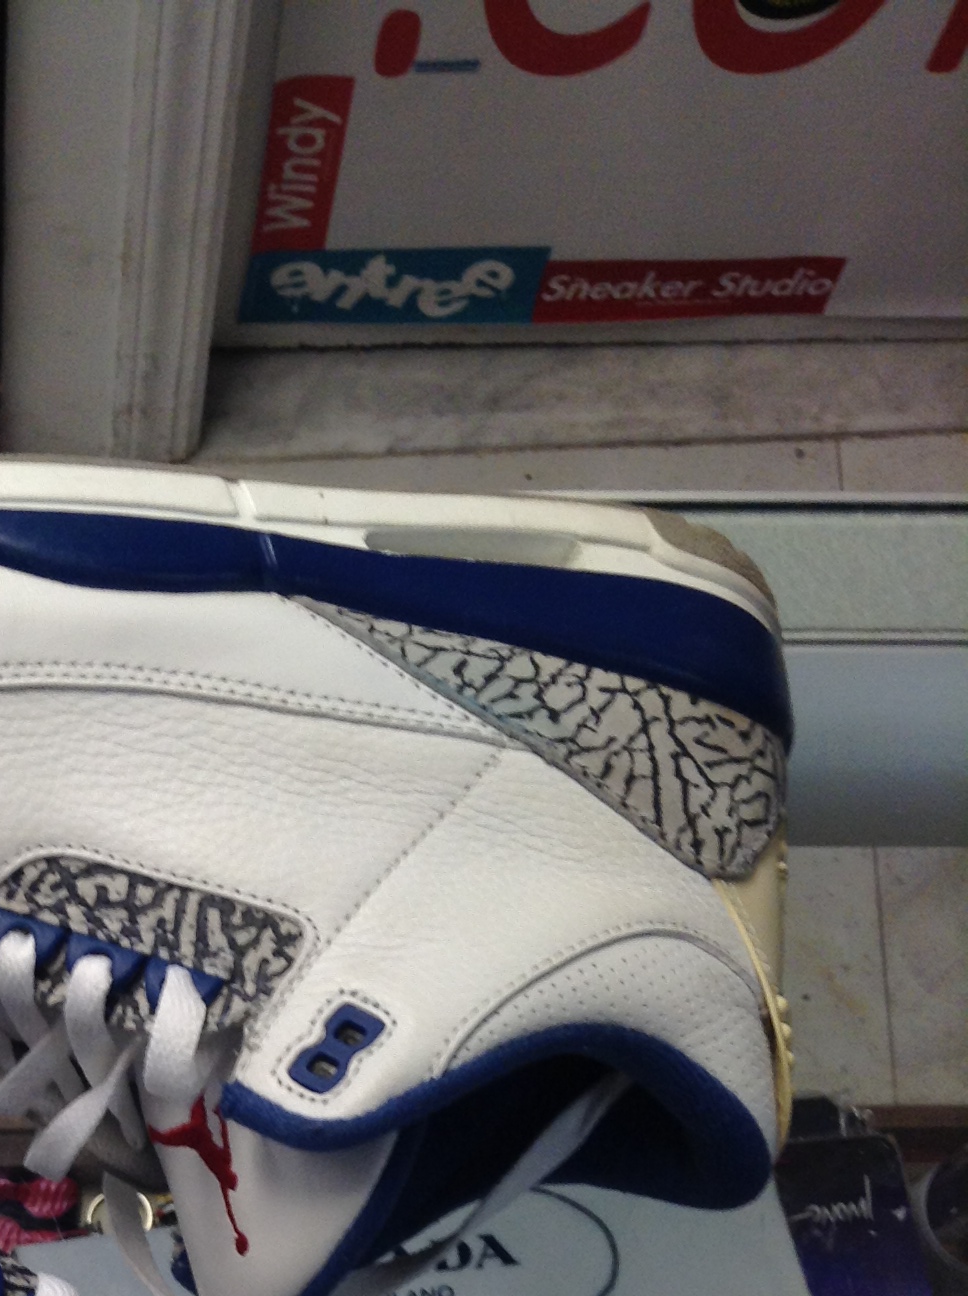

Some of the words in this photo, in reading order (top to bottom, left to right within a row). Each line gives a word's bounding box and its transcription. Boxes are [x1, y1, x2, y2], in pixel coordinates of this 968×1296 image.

[263, 98, 341, 232] Windy
[270, 255, 516, 317] entree
[541, 272, 711, 301] Sneaker
[715, 269, 833, 300] Studio
